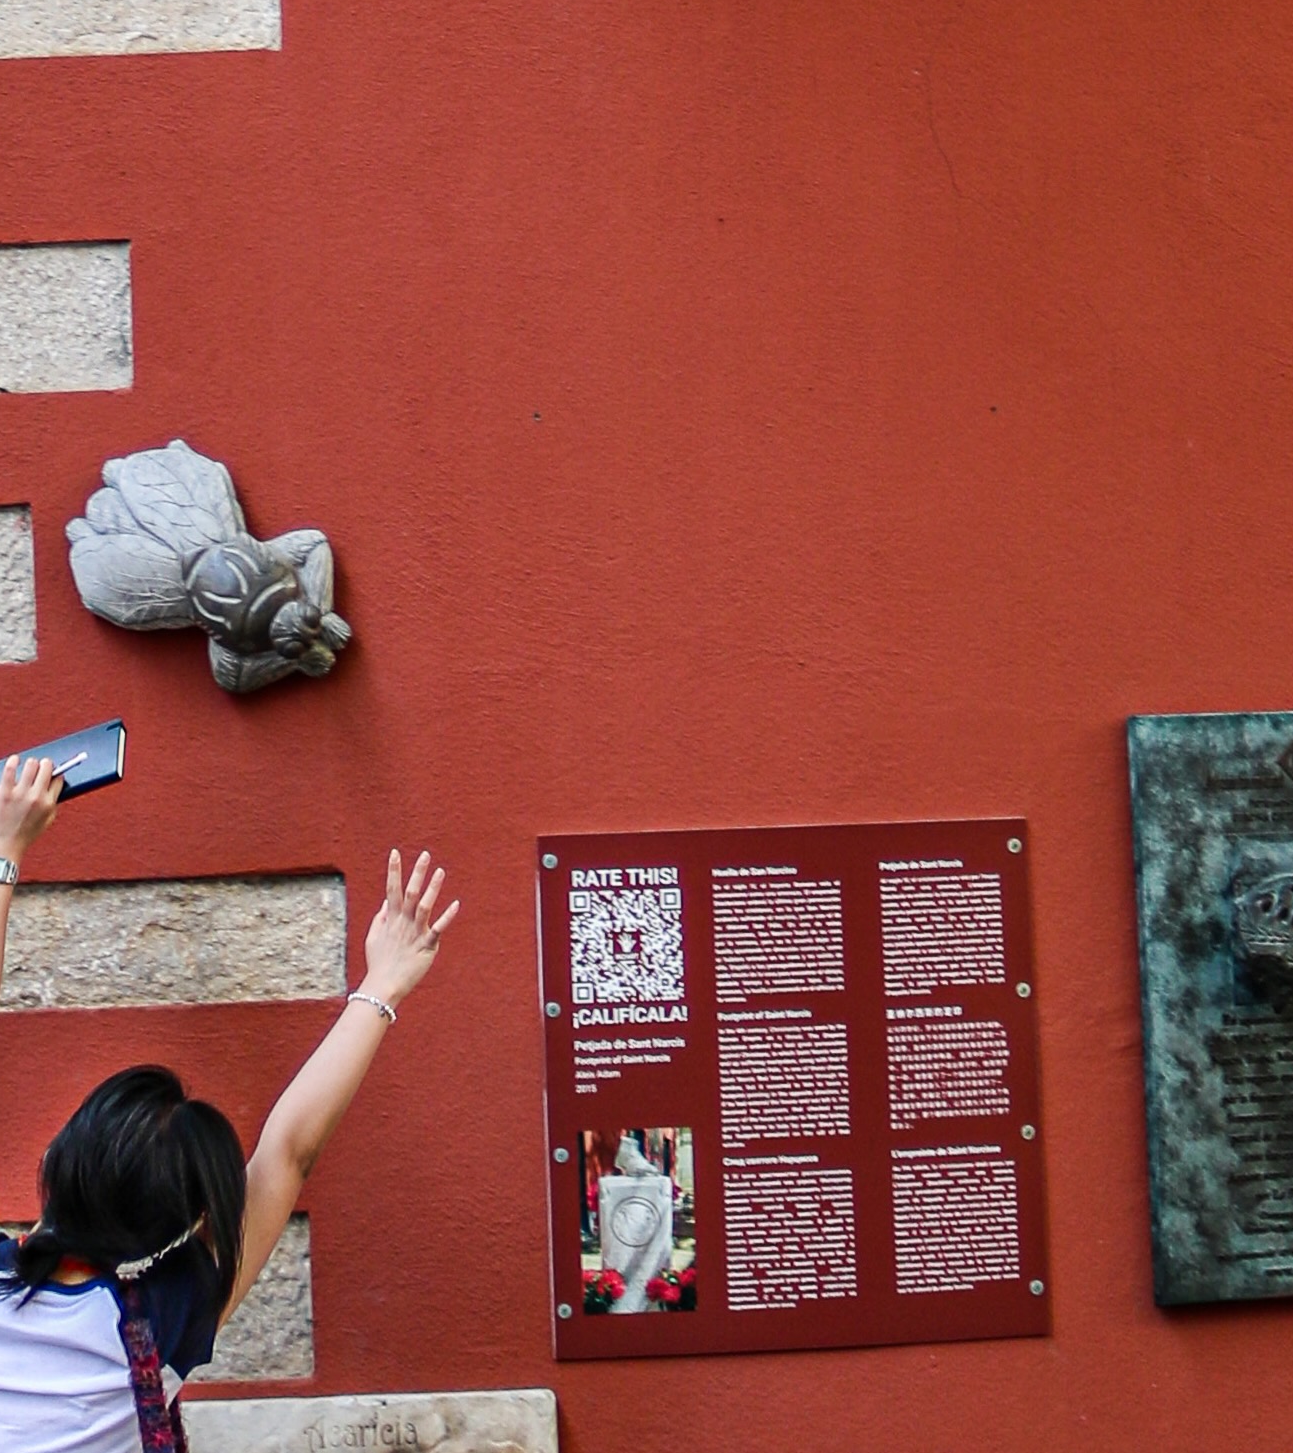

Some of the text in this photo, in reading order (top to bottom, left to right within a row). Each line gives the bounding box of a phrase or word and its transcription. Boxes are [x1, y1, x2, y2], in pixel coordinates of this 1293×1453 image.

[571, 867, 678, 888] RATE THIS!
[572, 1003, 688, 1028] ¡CALIFÍCALA!
[304, 1411, 419, 1453] Acaricia
